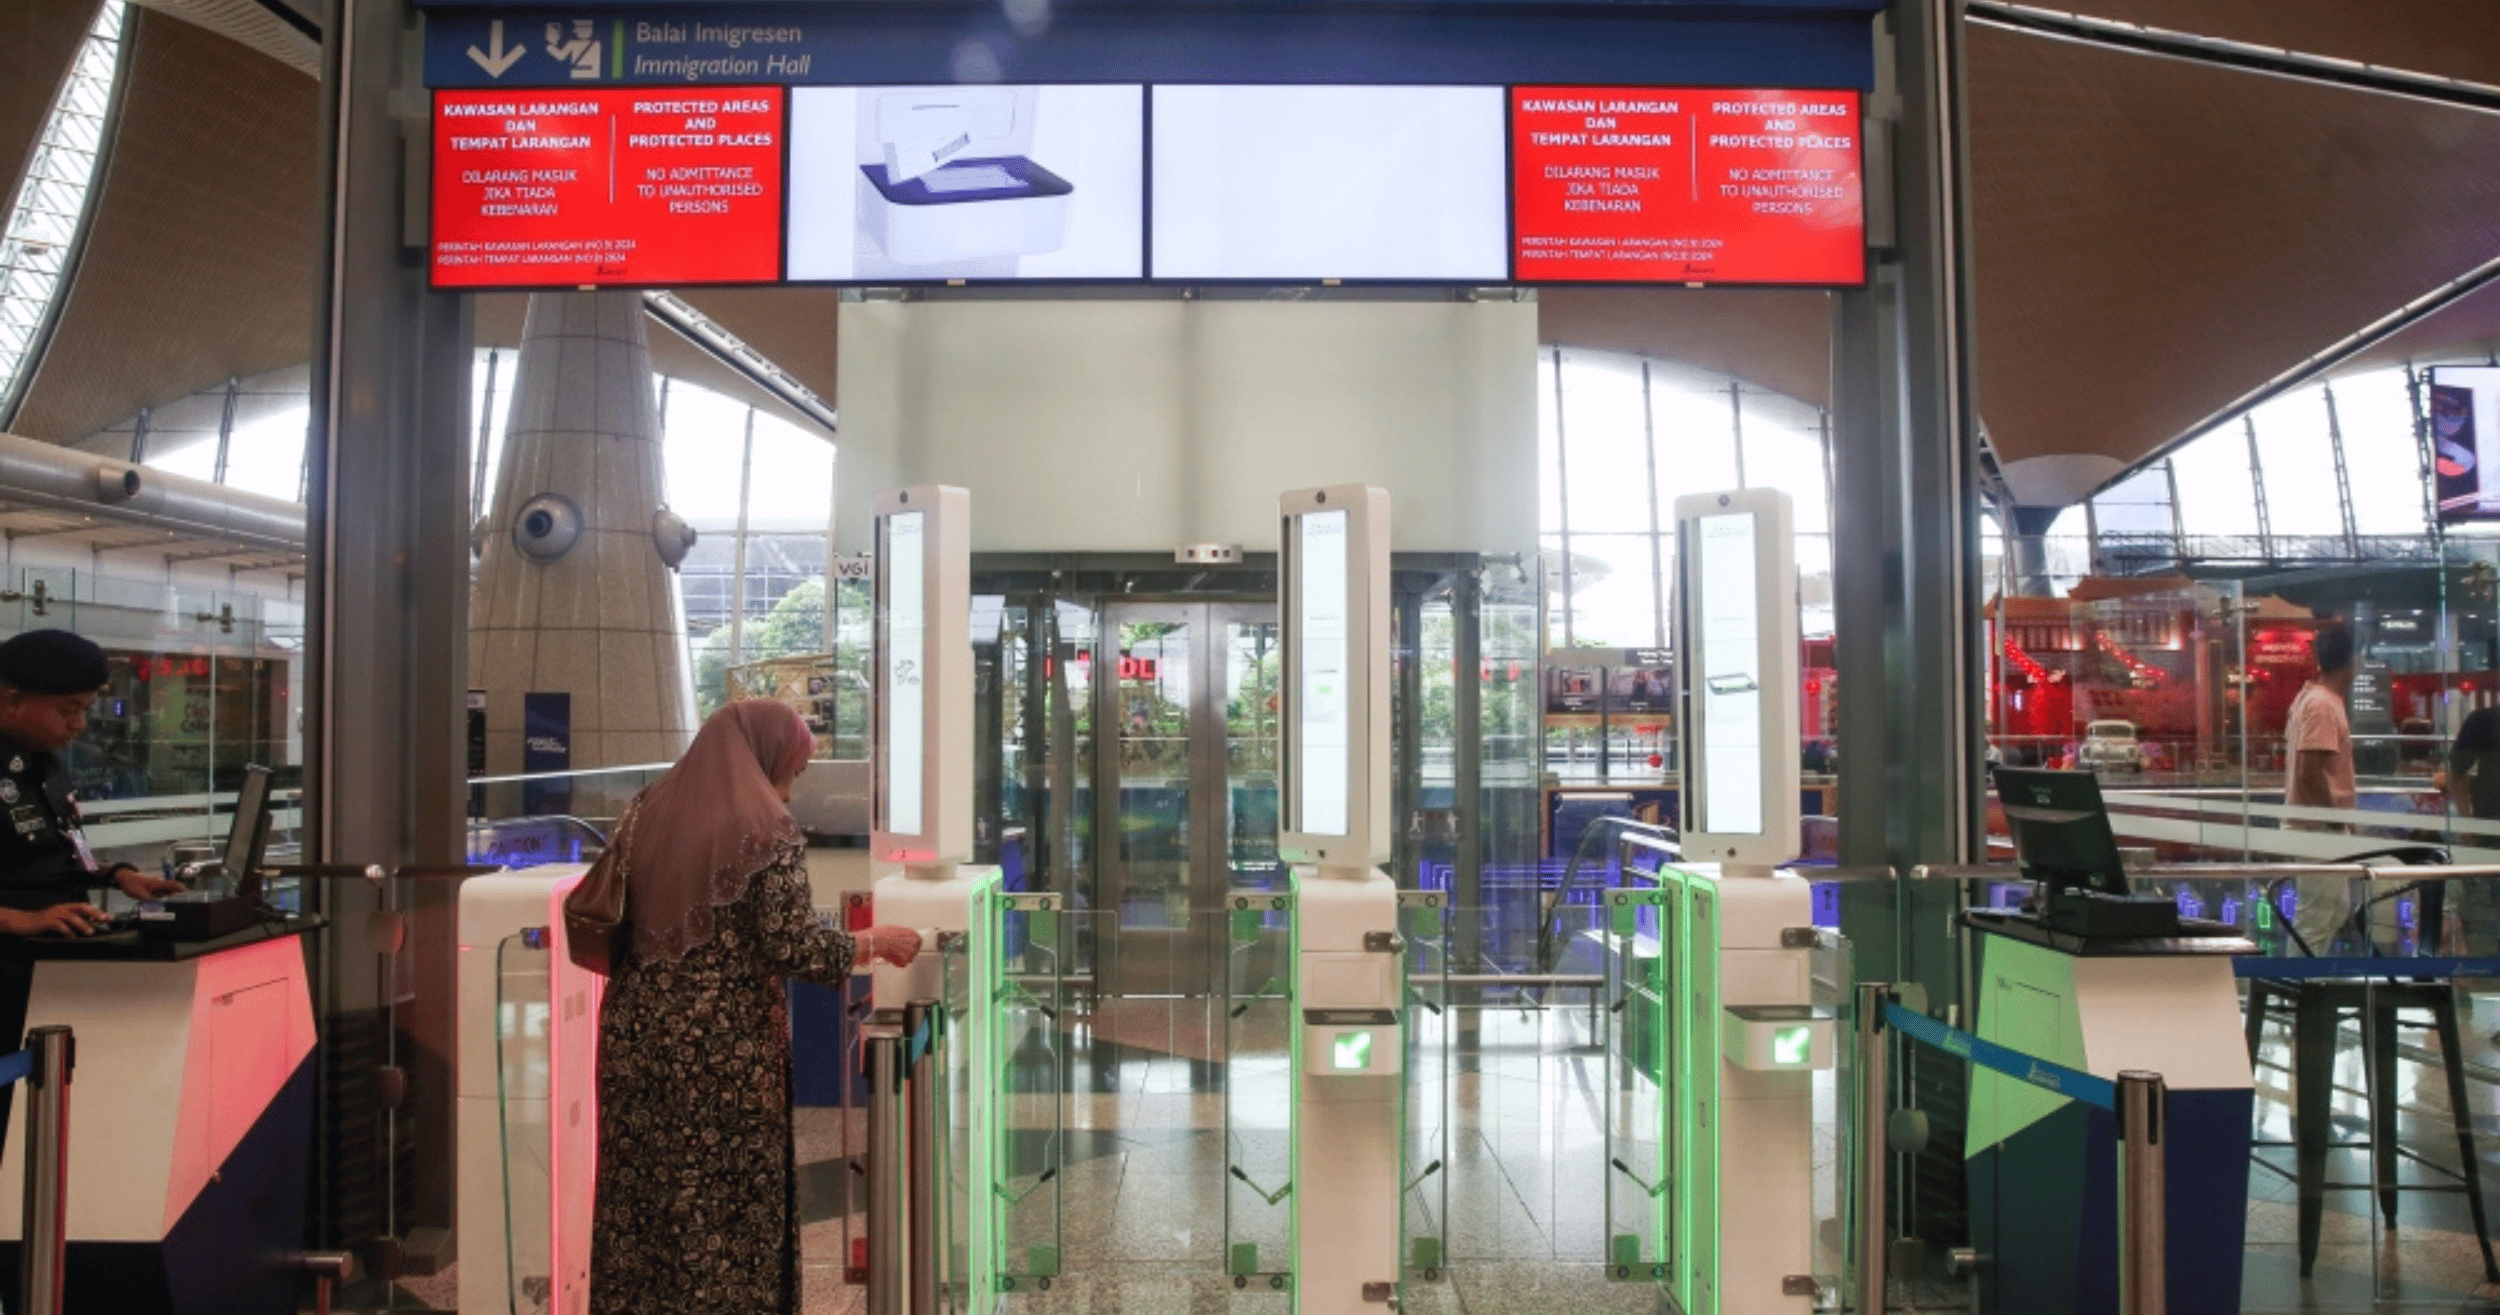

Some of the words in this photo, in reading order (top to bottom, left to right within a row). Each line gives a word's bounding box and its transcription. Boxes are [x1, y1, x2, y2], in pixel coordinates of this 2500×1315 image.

[637, 22, 687, 43] Balai
[695, 22, 803, 48] Imigresen
[634, 54, 759, 80] Immigration
[767, 54, 811, 75] Hall
[445, 104, 516, 115] KAWASAN
[520, 103, 598, 116] LARANGAN
[634, 101, 718, 113] PROTECTED
[722, 100, 769, 112] AREAS
[1523, 100, 1595, 112] KAWASAN
[1600, 101, 1678, 113] LARANGAN
[1712, 102, 1796, 115] PROTECTED
[1801, 104, 1846, 116] AREAS
[506, 120, 536, 132] DAN
[685, 118, 716, 129] AND
[1586, 117, 1616, 128] DAN
[1765, 119, 1796, 131] AND
[450, 136, 508, 150] TEMPAT
[512, 137, 590, 148] LARANGAN
[630, 134, 714, 146] PROTECTED
[718, 134, 772, 145] PLACES
[1531, 132, 1587, 146] TEMPAT
[1592, 134, 1671, 146] LARANGAN
[1709, 134, 1793, 147] PROTECTED
[1797, 135, 1850, 148] PLACES
